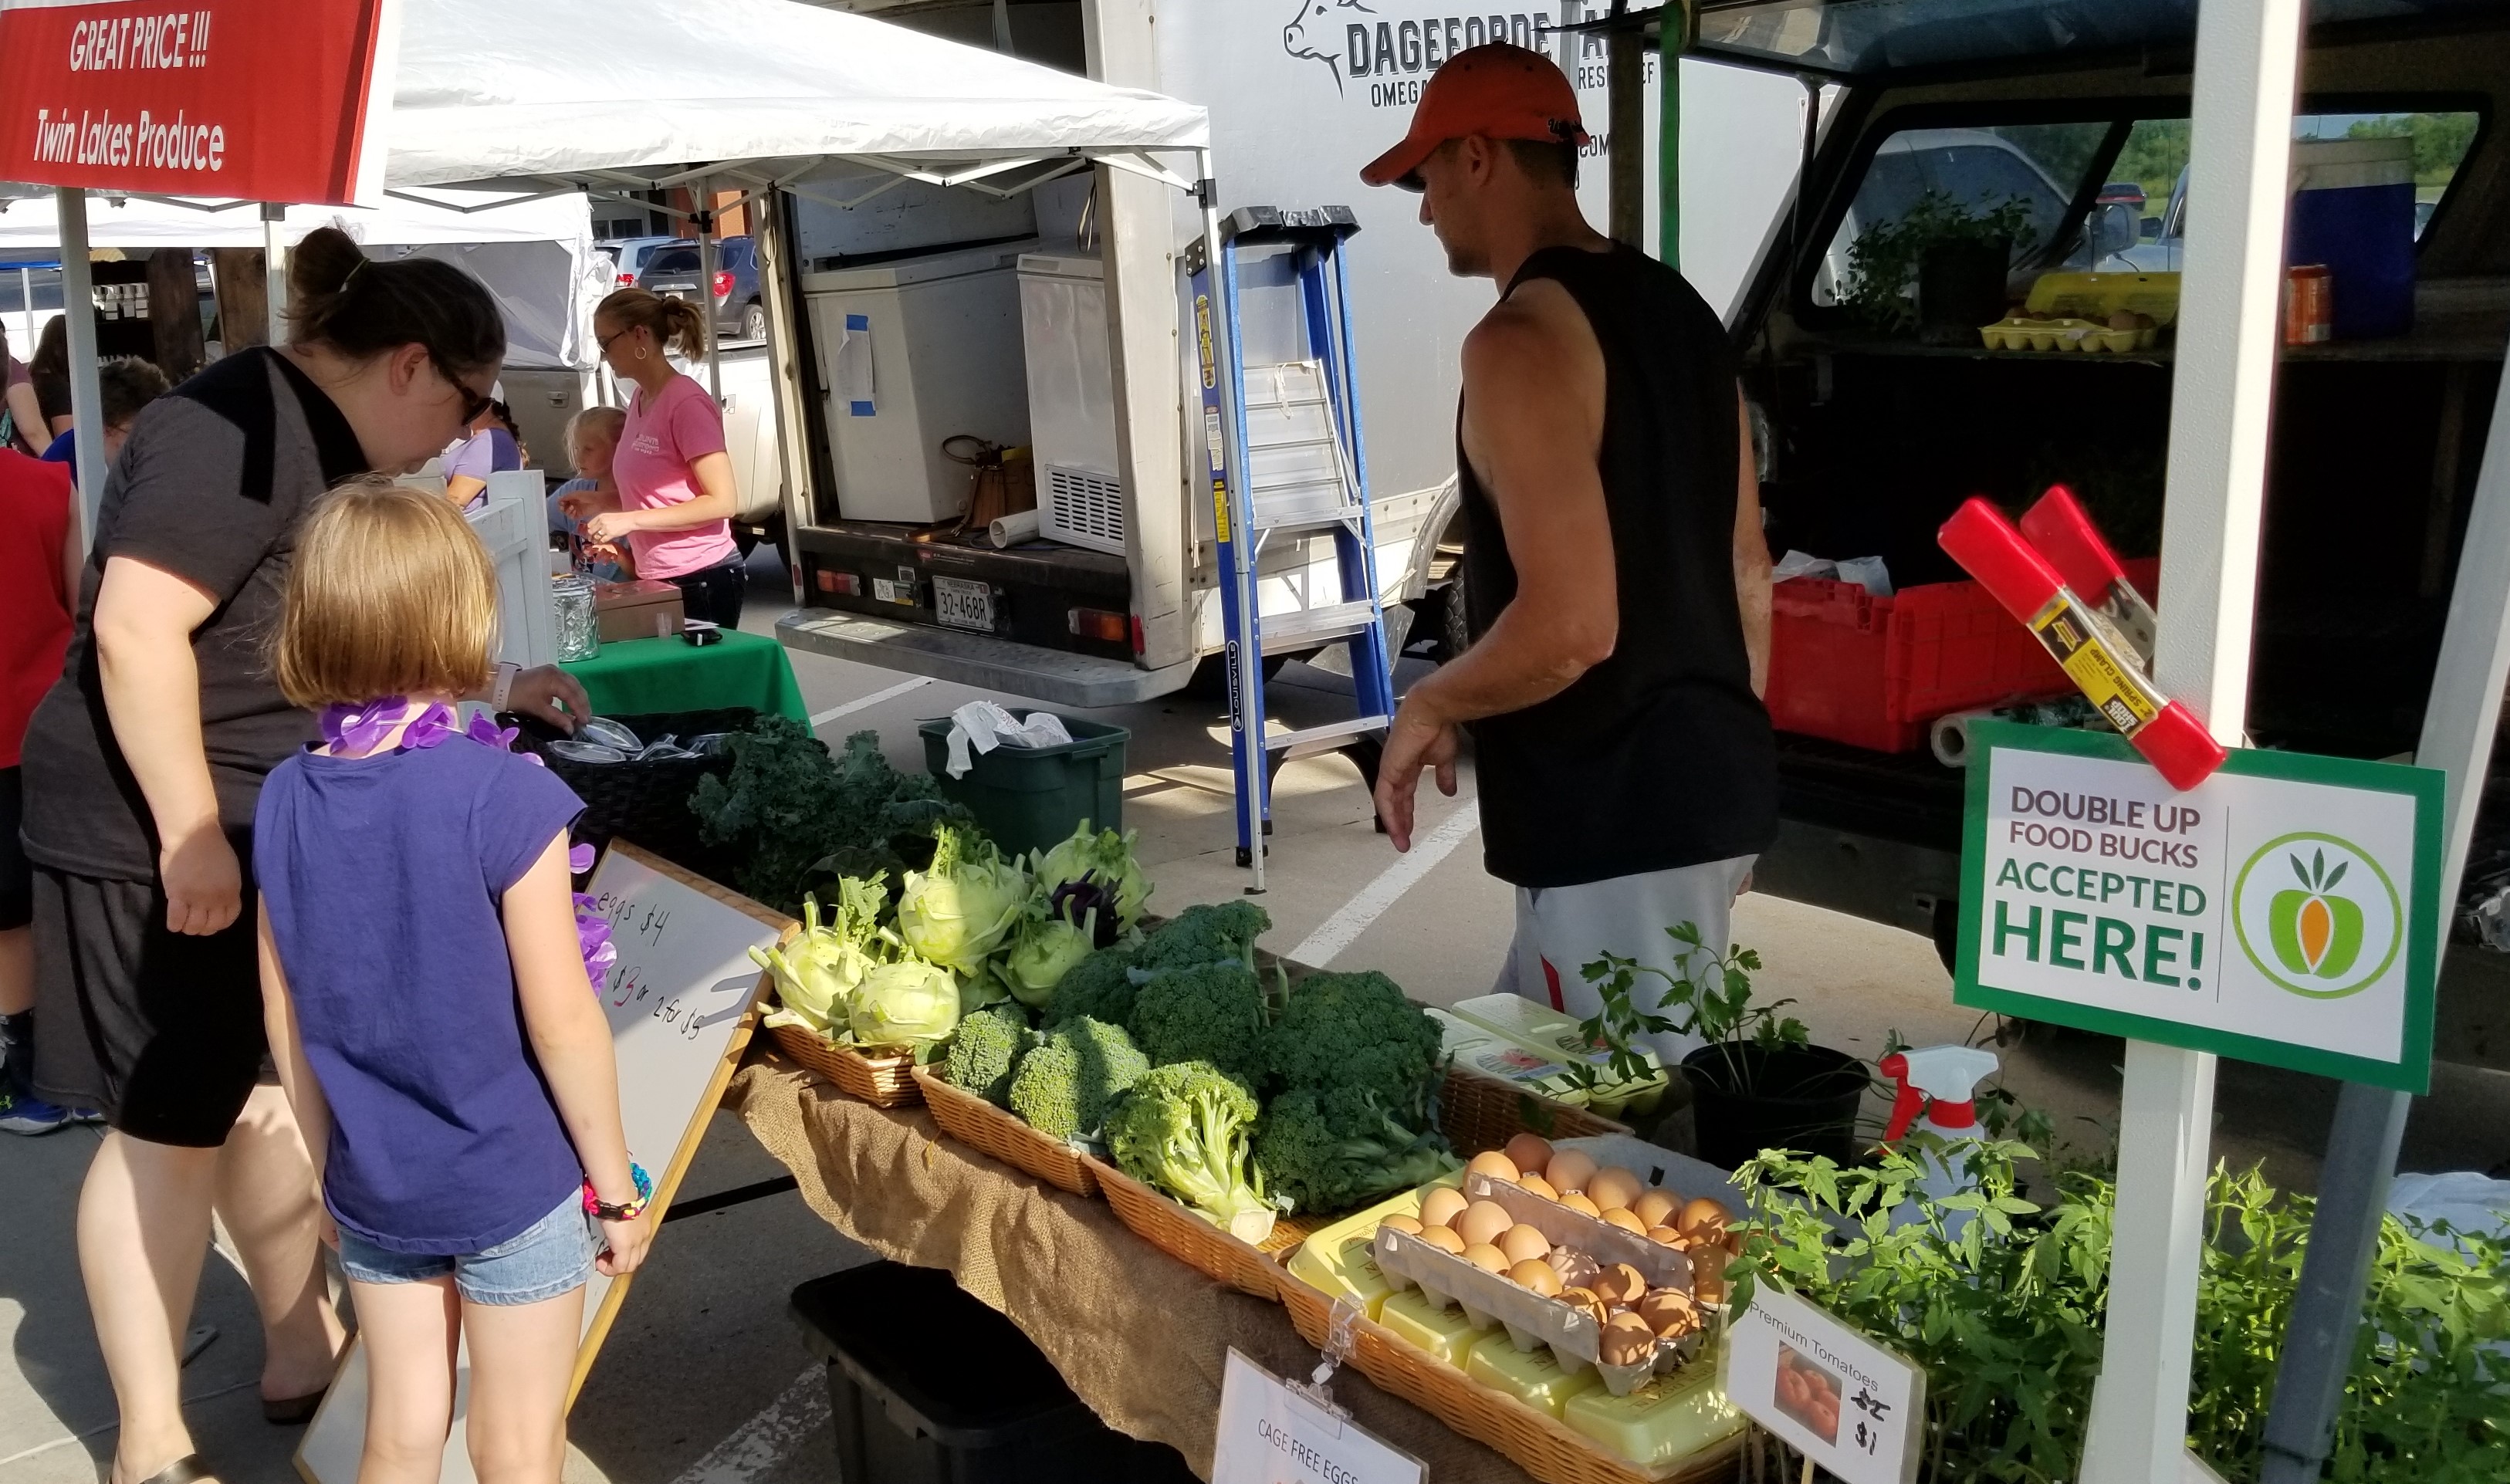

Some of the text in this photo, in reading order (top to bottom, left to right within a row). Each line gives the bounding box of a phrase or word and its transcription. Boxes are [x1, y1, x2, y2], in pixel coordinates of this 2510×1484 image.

[69, 10, 211, 72] GREAT PRICE !!!
[33, 107, 225, 171] Twin Lakes Produce
[940, 591, 987, 622] 32-468R
[1230, 644, 1240, 715] LOUISVILLE
[2089, 649, 2116, 676] CLAMP
[2111, 700, 2139, 728] SHOP
[2113, 676, 2142, 707] SPRING
[2106, 705, 2133, 733] TOOL
[2011, 786, 2201, 835] DOUBLE UP
[2010, 820, 2198, 869] FOOD BUCKS
[1995, 857, 2207, 917] ACCEPTED
[640, 903, 671, 947] $4
[1992, 900, 2204, 992] HERE!
[680, 1007, 705, 1041] $5
[1749, 1300, 1879, 1392] Premium Tomatoes
[1258, 1418, 1288, 1452] CAGE
[1291, 1438, 1321, 1473] FREE
[1855, 1421, 1877, 1456] $1
